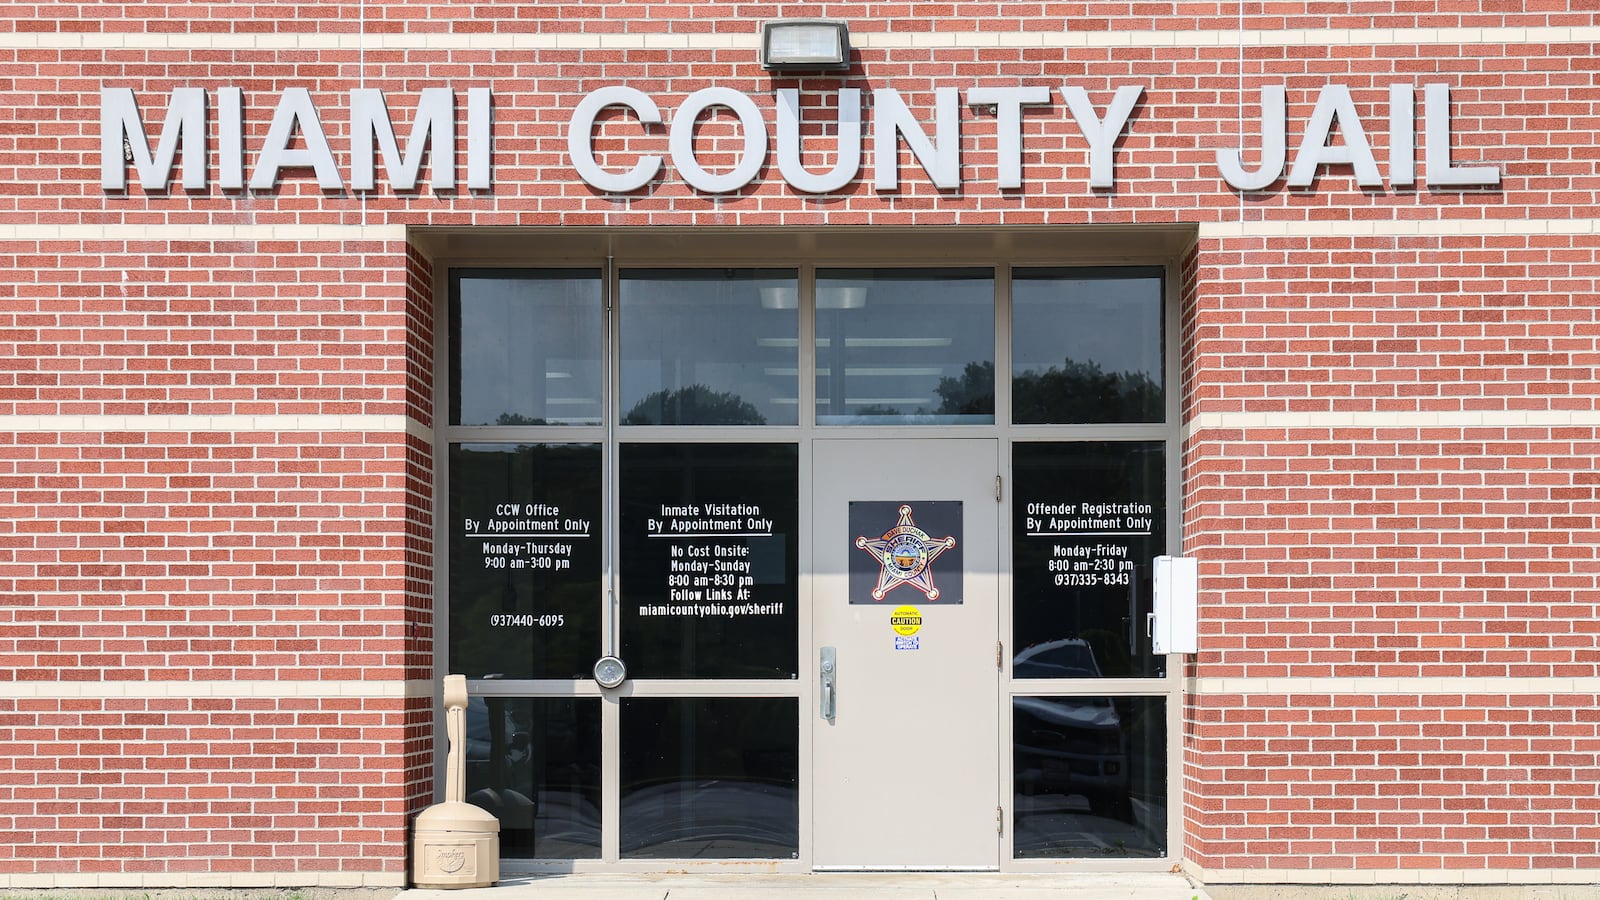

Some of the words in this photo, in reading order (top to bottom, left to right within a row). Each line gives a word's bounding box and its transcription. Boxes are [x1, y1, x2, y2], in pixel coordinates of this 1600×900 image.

[101, 87, 491, 191] MIAMI
[568, 85, 1145, 193] COUNTY
[1216, 83, 1500, 191] JAIL
[496, 504, 520, 516] CCW
[526, 504, 559, 516] Office
[661, 504, 699, 516] Inmate
[705, 503, 760, 516] Visitation
[1027, 503, 1076, 515] Offender
[1082, 502, 1152, 517] Registration
[465, 518, 480, 533] By
[488, 518, 559, 533] Appointment
[564, 518, 590, 533] Only
[648, 518, 663, 533] By
[671, 518, 742, 533] Appointment
[747, 517, 773, 533] Only
[1026, 517, 1042, 532] By
[1049, 517, 1121, 532] Appointment
[1127, 516, 1152, 532] Only
[886, 527, 902, 538] DAVE
[483, 542, 572, 556] Monday-Thursday
[671, 545, 684, 557] No
[688, 545, 711, 557] Cost
[714, 545, 750, 557] Onsite:
[886, 536, 926, 553] SHERIFF
[1053, 544, 1128, 558] Monday-Friday
[485, 557, 506, 569] 9:00
[510, 557, 552, 569] am-3:00
[556, 559, 570, 571] pm
[671, 559, 751, 573] Monday-Sunday
[888, 562, 902, 576] MIAMI
[904, 562, 925, 577] COUNTY
[1048, 559, 1070, 572] 8:00
[1073, 558, 1115, 571] am-2:30
[1119, 561, 1134, 573] pm
[669, 574, 690, 587] 8:00
[694, 574, 735, 587] am-8:30
[739, 576, 753, 588] pm
[1054, 572, 1129, 586] (937)335-8343
[671, 588, 702, 601] Follow
[706, 588, 732, 601] Links
[737, 587, 751, 601] At:
[639, 602, 784, 618] miamicountyohio.gov/sheriff
[490, 614, 564, 627] (937)440-6095
[892, 617, 921, 625] CAUTION
